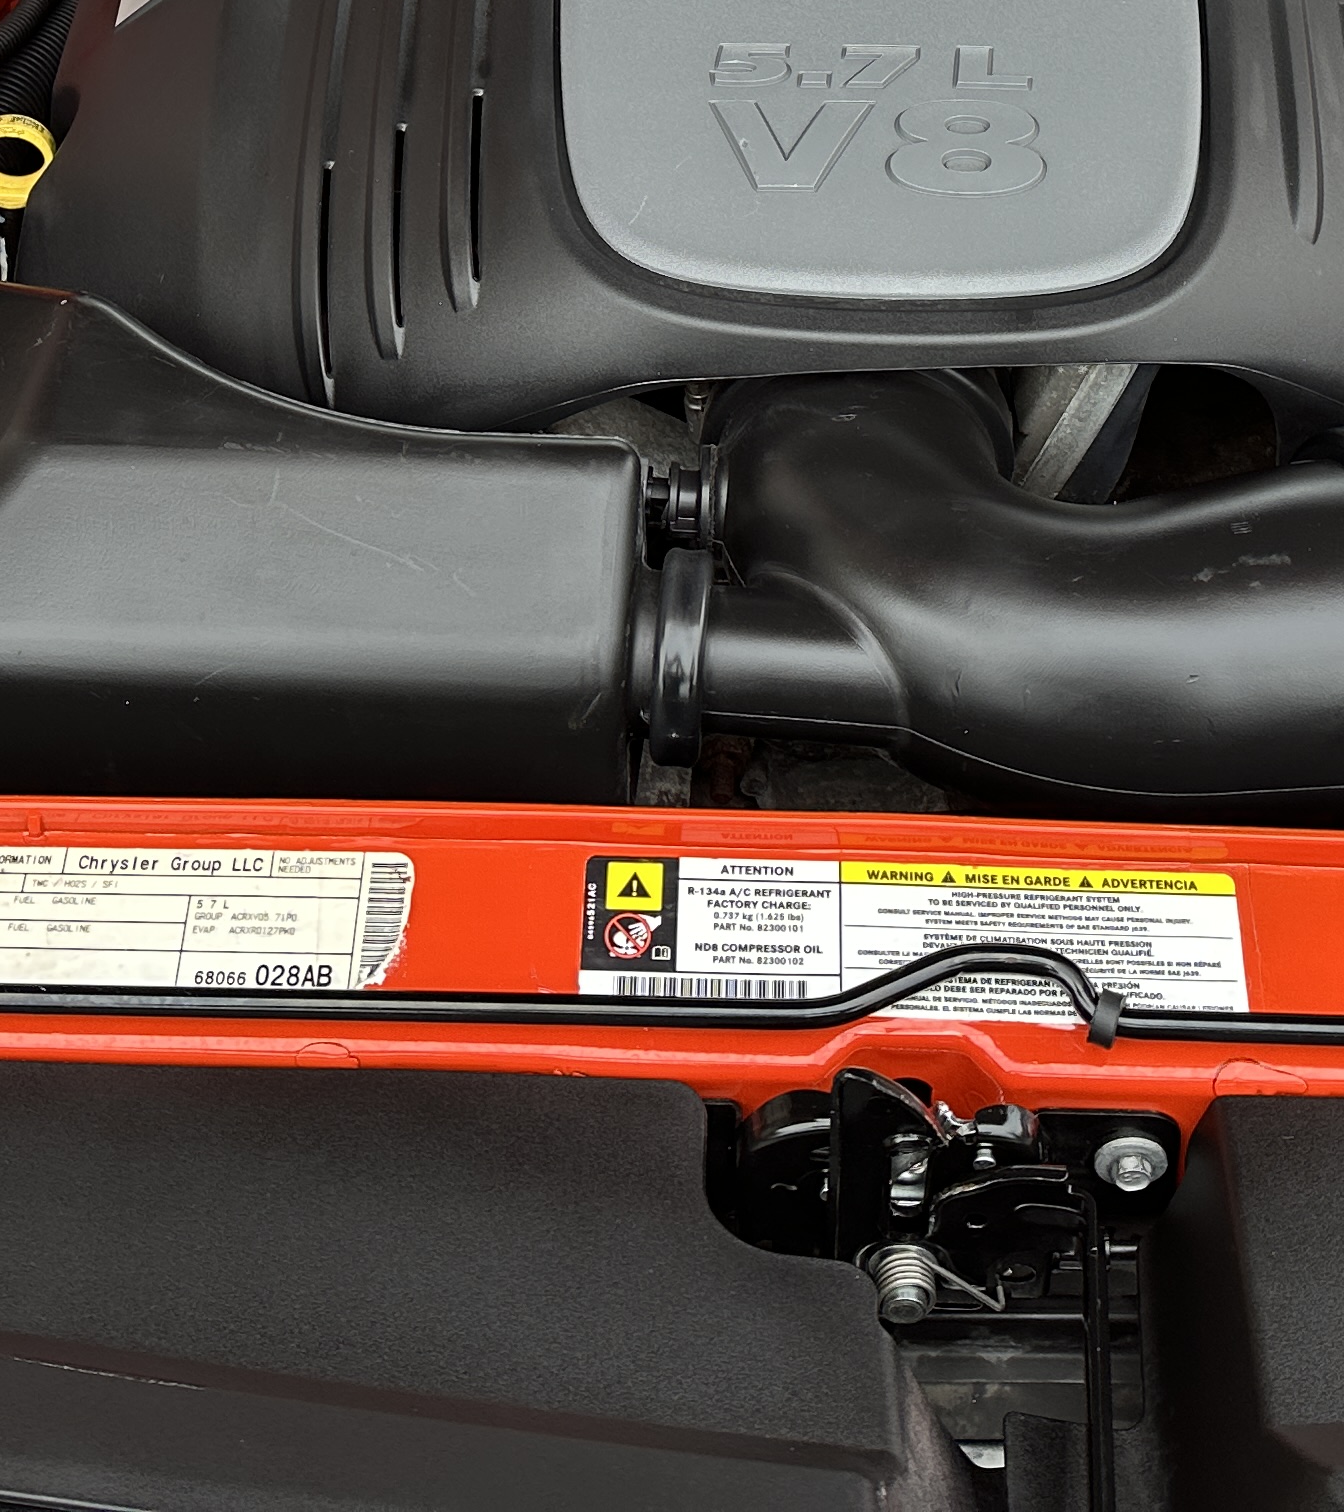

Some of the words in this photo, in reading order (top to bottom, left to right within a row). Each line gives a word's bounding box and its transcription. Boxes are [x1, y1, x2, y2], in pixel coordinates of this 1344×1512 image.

[708, 99, 1048, 197] V8
[78, 855, 159, 875] Chrysler
[171, 857, 222, 876] Group
[231, 858, 264, 872] LLC
[279, 857, 291, 866] NO
[296, 857, 357, 867] ADJUSTMENTS
[278, 865, 312, 874] NEEDED
[720, 865, 794, 877] ATTENTION
[867, 869, 935, 882] WARNING
[965, 873, 999, 885] MISE
[1002, 875, 1020, 886] EN
[1024, 876, 1071, 888] GARDE
[1102, 878, 1199, 892] ADVERTENCIA
[688, 886, 727, 896] R-134a
[729, 887, 752, 898] A/C
[755, 888, 832, 899] REFRIGERANT
[951, 891, 1022, 901] HIGH-PRESSURE
[1024, 894, 1083, 903] REFRIGERANT
[1086, 895, 1121, 904] SYSTEM
[13, 896, 36, 905] FUEL
[51, 896, 97, 906] GASOLINE
[707, 899, 759, 910] FACTORY
[762, 900, 812, 911] CHARGE:
[928, 898, 940, 906] TO
[942, 899, 953, 907] BE
[955, 900, 998, 908] SERVICED
[1000, 901, 1011, 909] BY
[1014, 902, 1061, 911] QUALIFIED
[1063, 903, 1116, 913] PERSONNEL
[194, 911, 224, 921] GROUP
[713, 912, 740, 921] 0.737
[742, 912, 754, 923] kg
[787, 913, 805, 923] lbs)
[912, 908, 943, 917] SERVICE
[978, 911, 1015, 920] IMPROPER
[1016, 912, 1047, 921] SERVICE
[1048, 914, 1084, 922] METHODS
[1085, 915, 1100, 923] MAY
[1101, 916, 1125, 924] CAUSE
[1126, 917, 1164, 925] PERSONAL
[7, 923, 30, 933] FUEL
[46, 924, 93, 934] GASOLINE
[192, 925, 216, 935] EVAP
[713, 923, 738, 932] PART
[739, 924, 755, 932] No.
[757, 924, 805, 933] 82300101
[925, 918, 953, 926] SYSTEM
[955, 919, 979, 927] MEETS
[980, 920, 1006, 928] SAFETY
[1092, 924, 1130, 933] STANDARD
[923, 933, 964, 942] SYSTÈME
[966, 934, 978, 943] DE
[980, 935, 1048, 945] CLIMATISATION
[1050, 938, 1076, 947] SOUS
[1076, 939, 1107, 948] HAUTE
[1108, 940, 1154, 949] PRESSION
[695, 943, 720, 952] ND8
[721, 943, 801, 954] COMPRESSOR
[804, 945, 824, 955] OIL
[712, 956, 737, 965] PART
[739, 956, 754, 965] No.
[756, 957, 805, 966] 82300102
[194, 972, 247, 986] 68066
[255, 964, 333, 988] 028AB
[980, 977, 994, 986] DE
[943, 986, 968, 994] DEBE
[969, 987, 986, 995] SER
[988, 988, 1037, 998] REPARADO
[1039, 990, 1059, 999] POR
